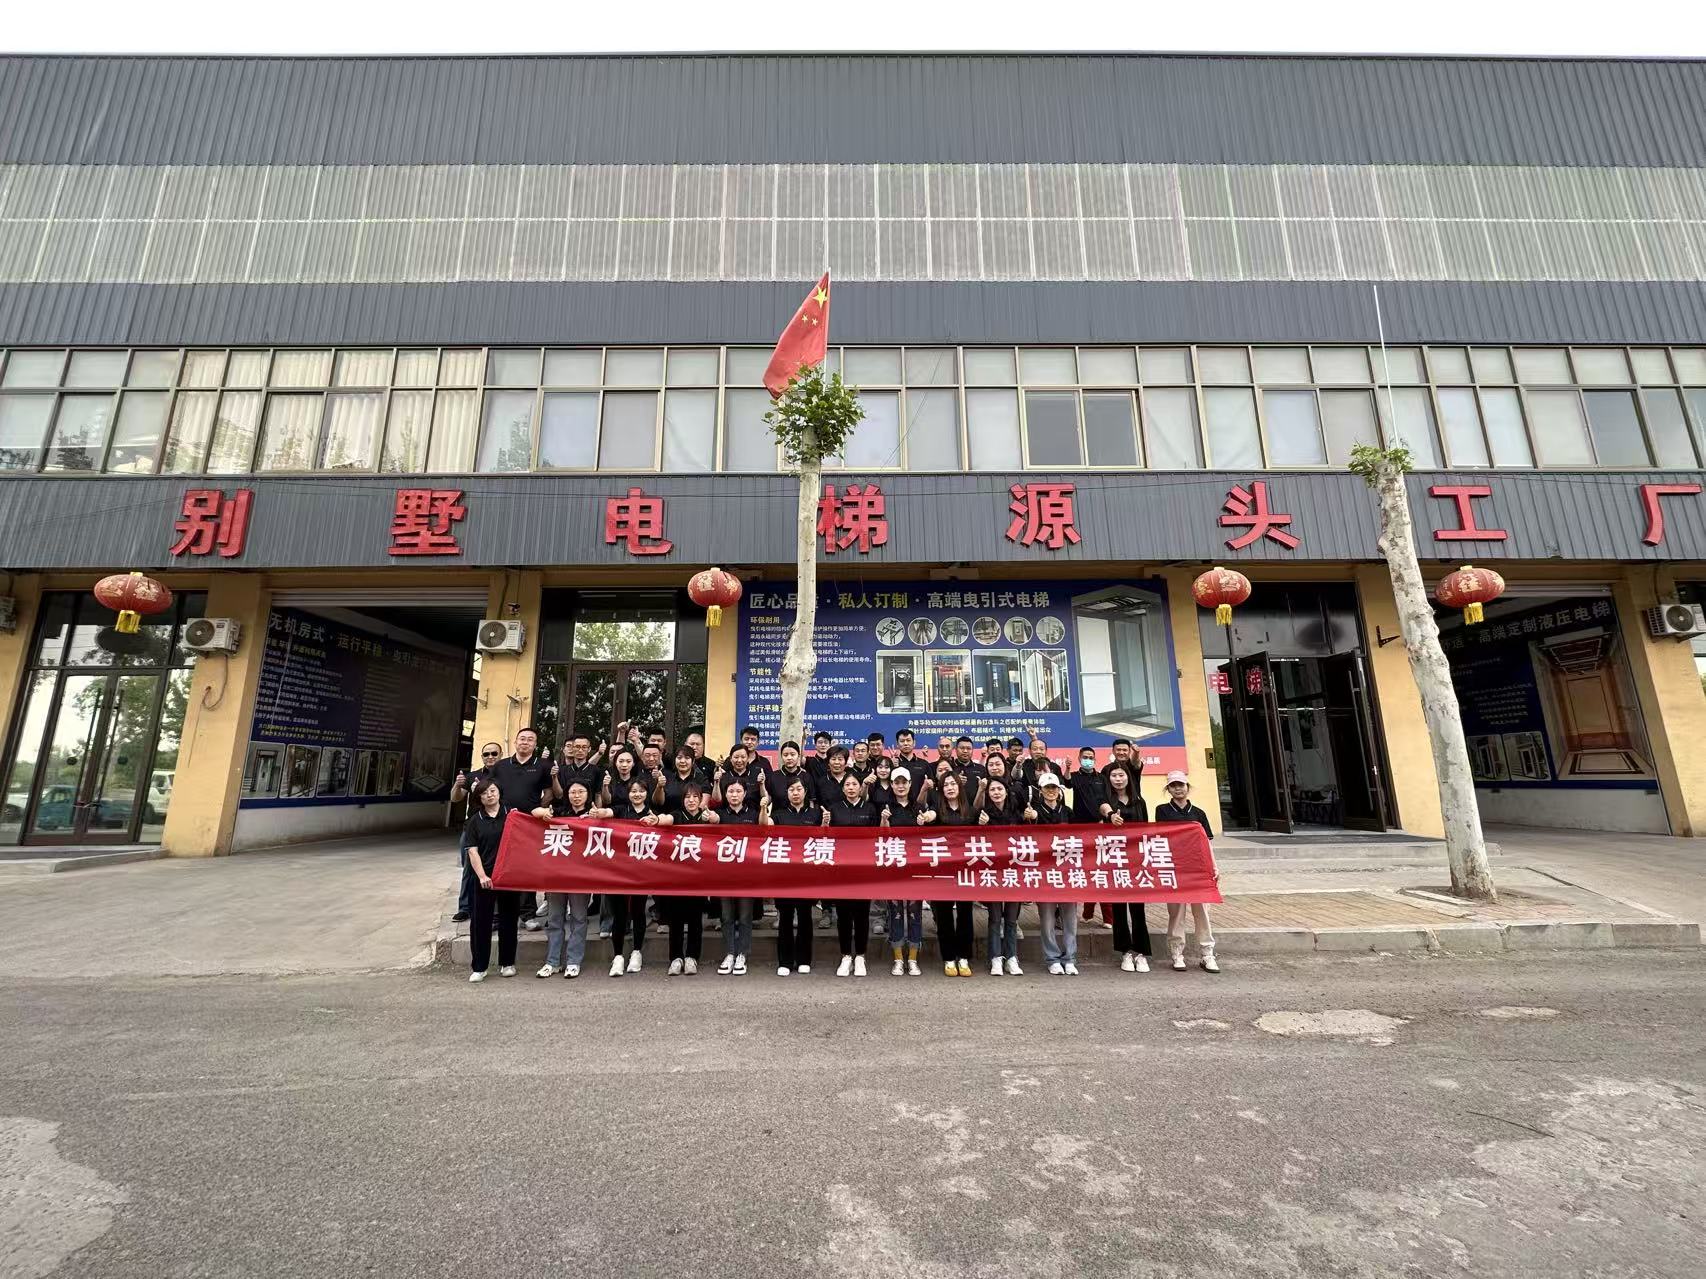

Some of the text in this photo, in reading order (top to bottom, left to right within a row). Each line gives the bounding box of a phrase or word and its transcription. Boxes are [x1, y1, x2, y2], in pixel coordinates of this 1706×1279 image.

[169, 481, 1702, 558] 别墅电梯源头工厂
[750, 592, 1050, 609] 匠心品·私人订制·高端曳引式电梯
[540, 824, 1175, 870] 乘风破浪创佳绩 携手共进铸辉煌
